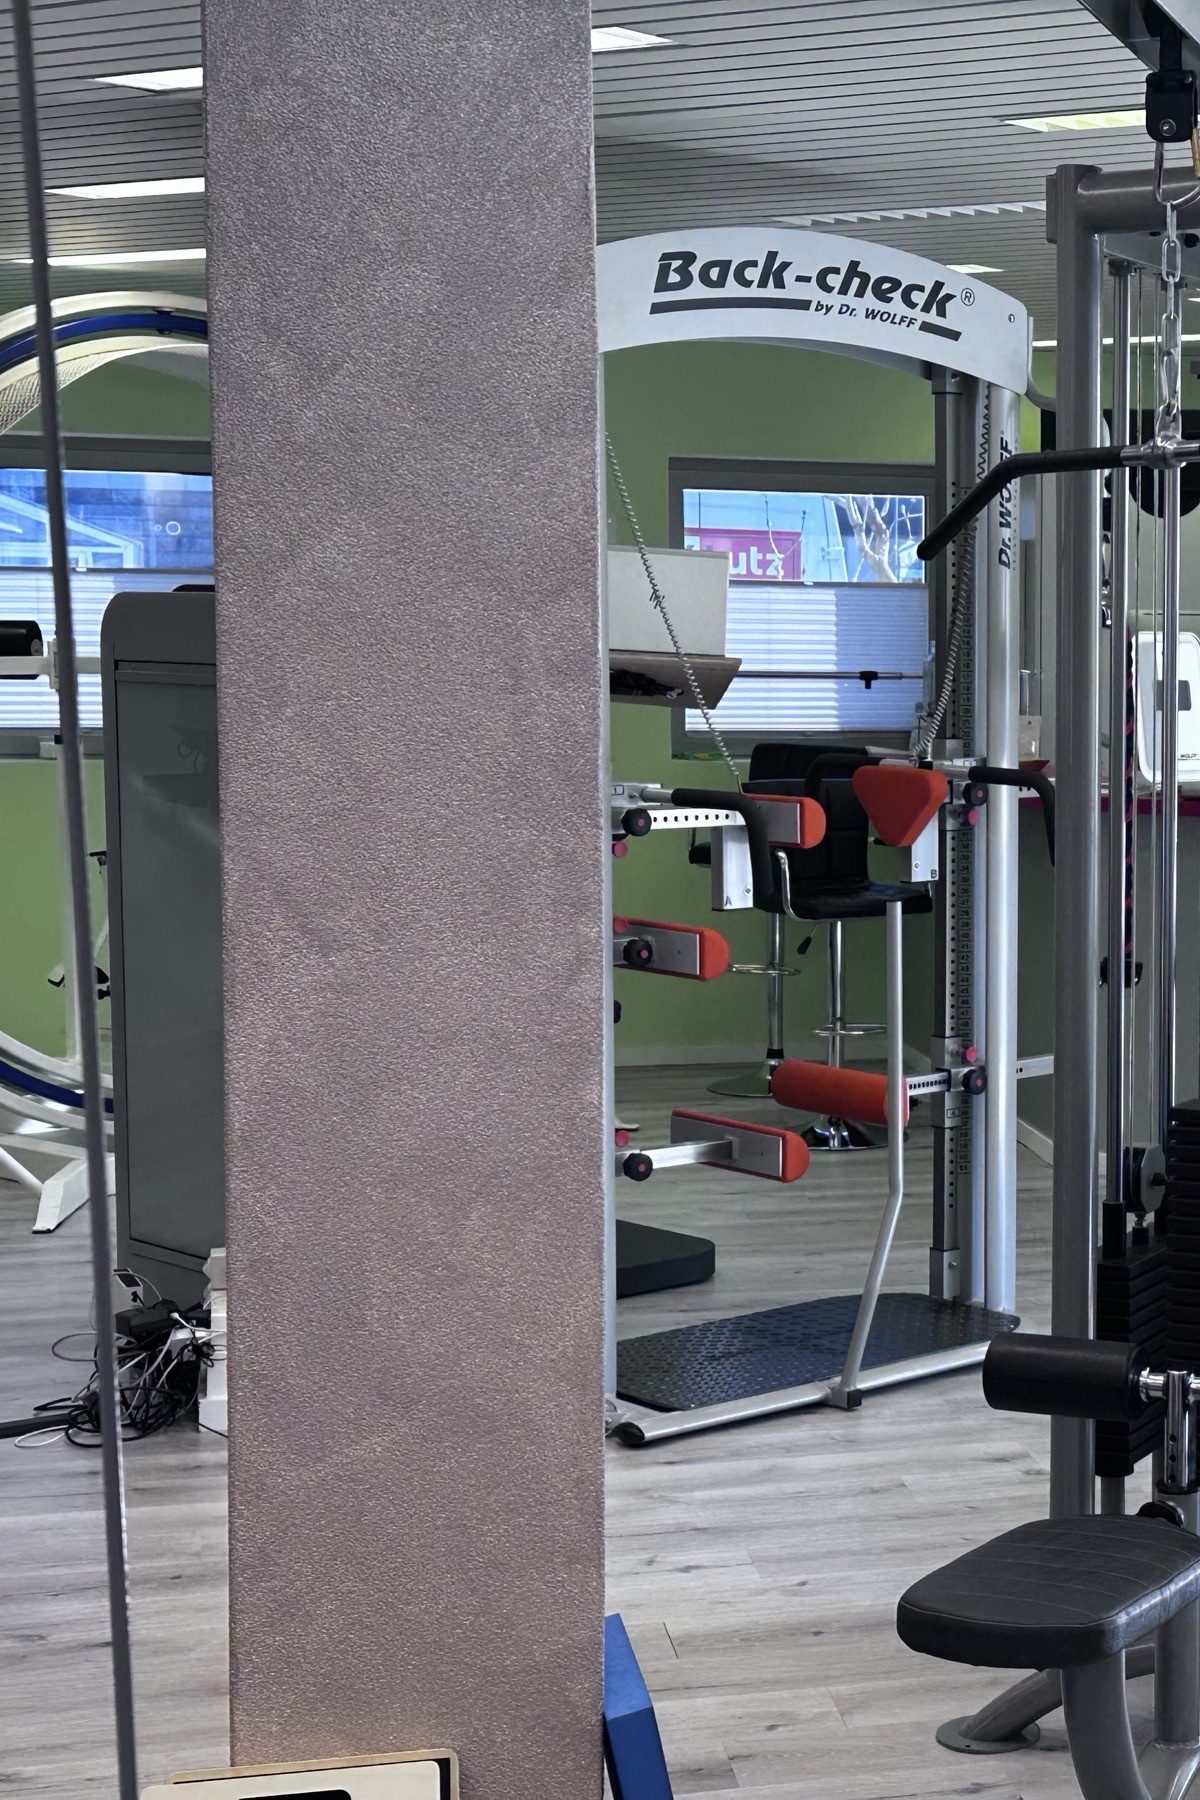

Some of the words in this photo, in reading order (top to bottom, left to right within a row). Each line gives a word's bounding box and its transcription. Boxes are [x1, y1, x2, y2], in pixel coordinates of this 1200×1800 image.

[814, 300, 834, 316] by
[837, 303, 857, 318] Dr.
[864, 307, 918, 328] WOLFF
[998, 537, 1012, 570] Dr.
[930, 869, 938, 879] B
[724, 895, 733, 907] A
